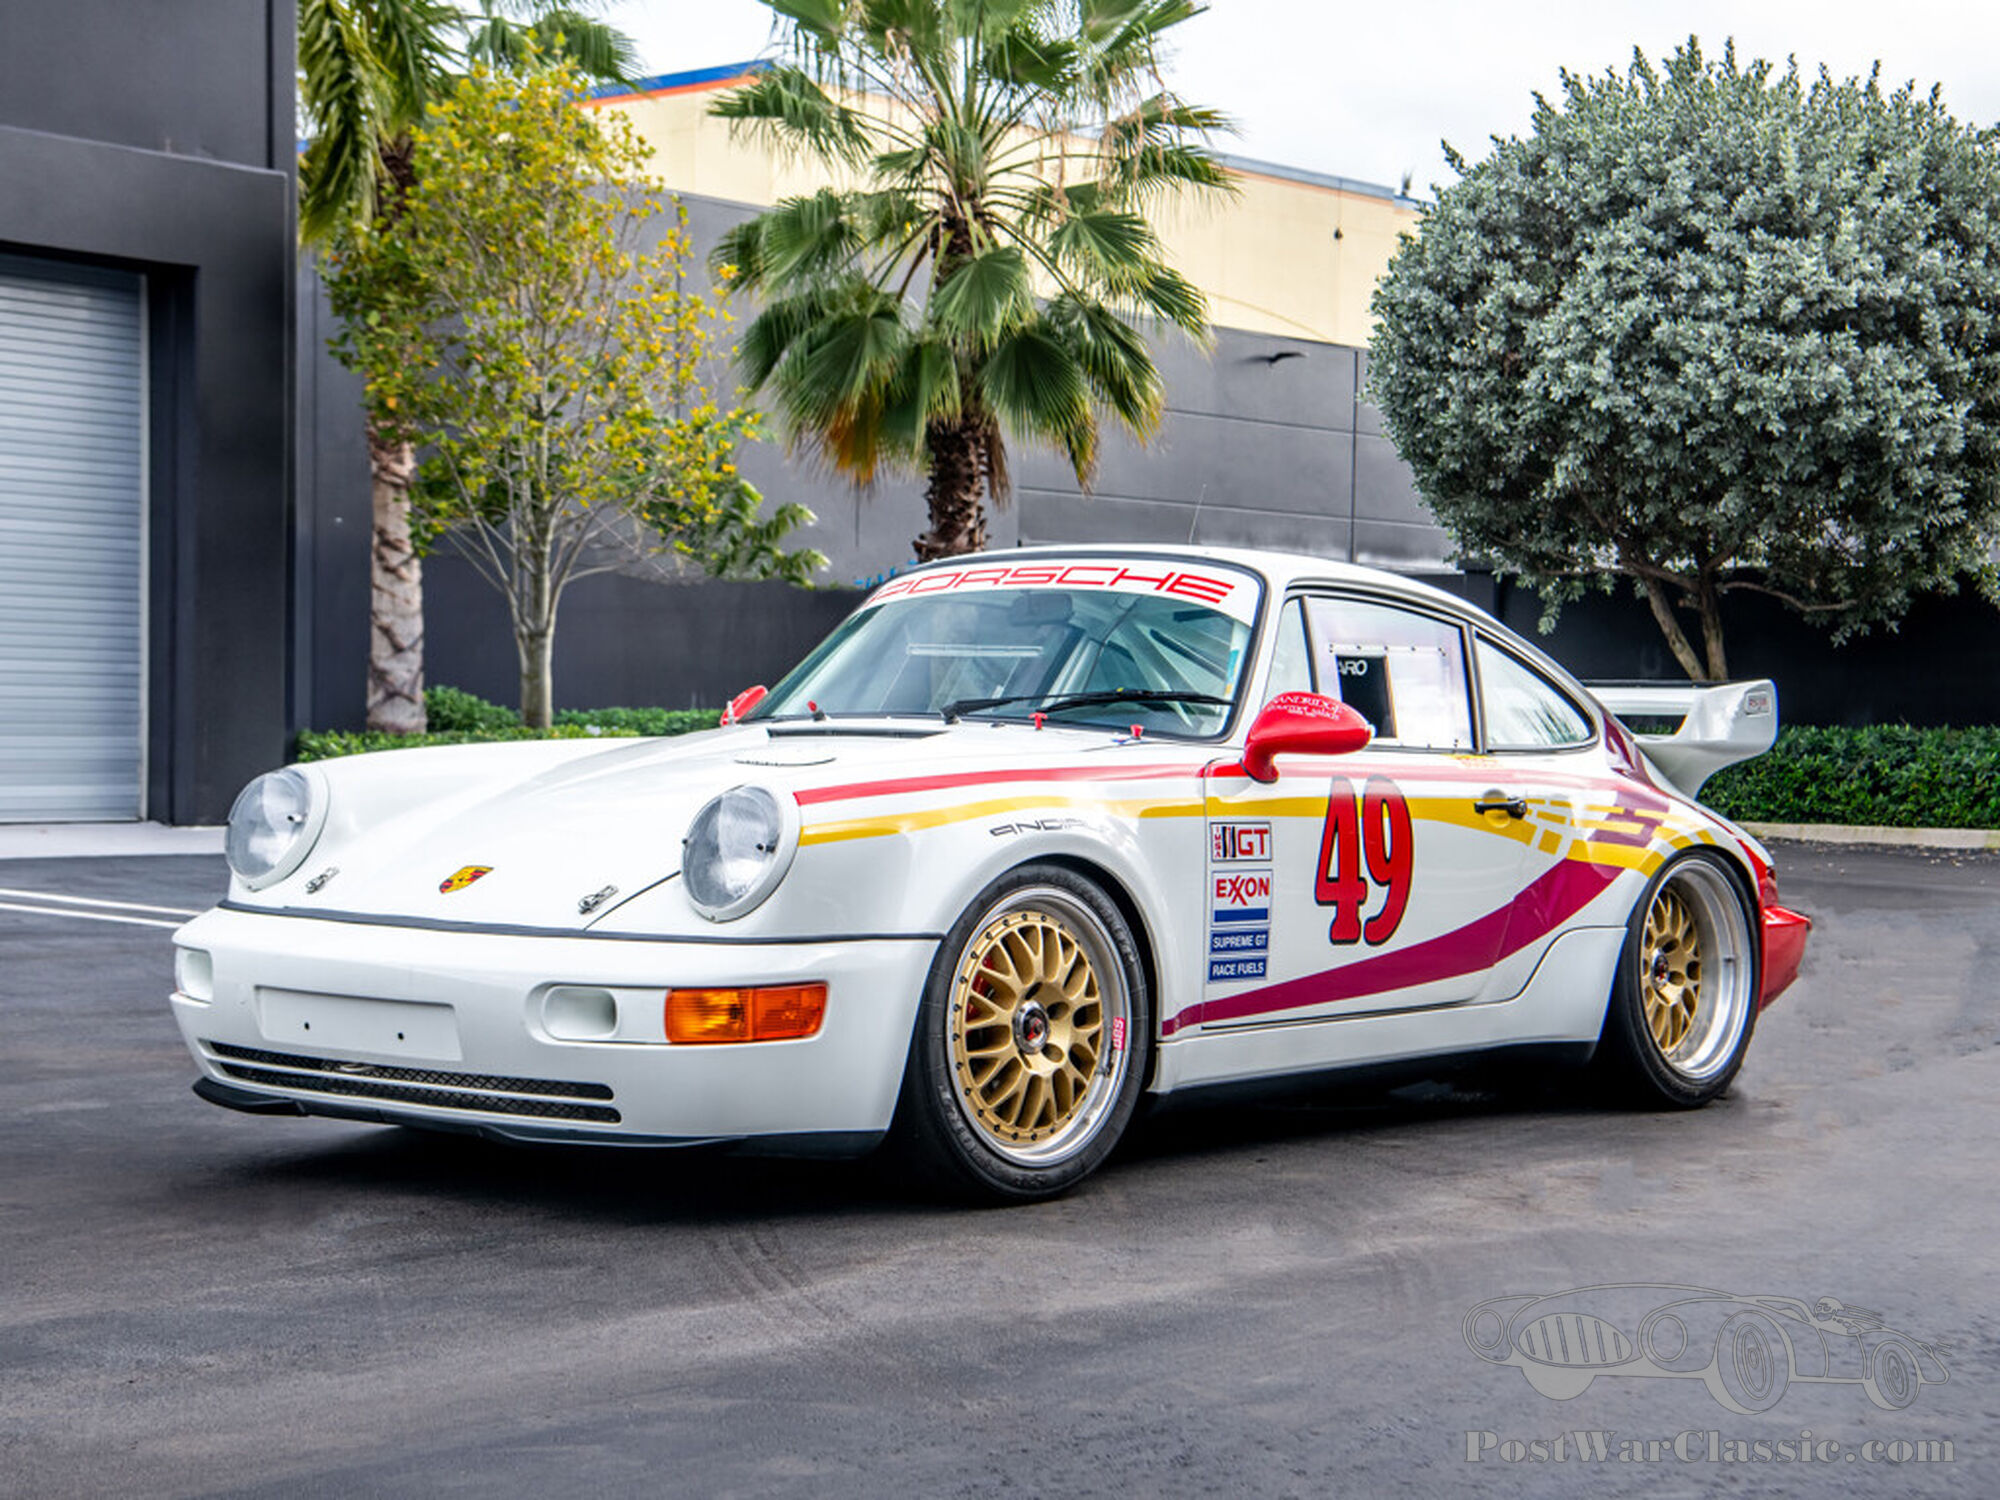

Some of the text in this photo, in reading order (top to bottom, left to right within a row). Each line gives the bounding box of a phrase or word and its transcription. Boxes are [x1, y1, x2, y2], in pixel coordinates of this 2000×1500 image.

[864, 566, 1235, 608] PORSCHE
[1237, 829, 1269, 856] GT
[1315, 774, 1414, 946] 49
[1215, 875, 1270, 906] EXXON
[1213, 934, 1267, 949] SUPREME GT
[1212, 961, 1265, 977] RACE FUELS
